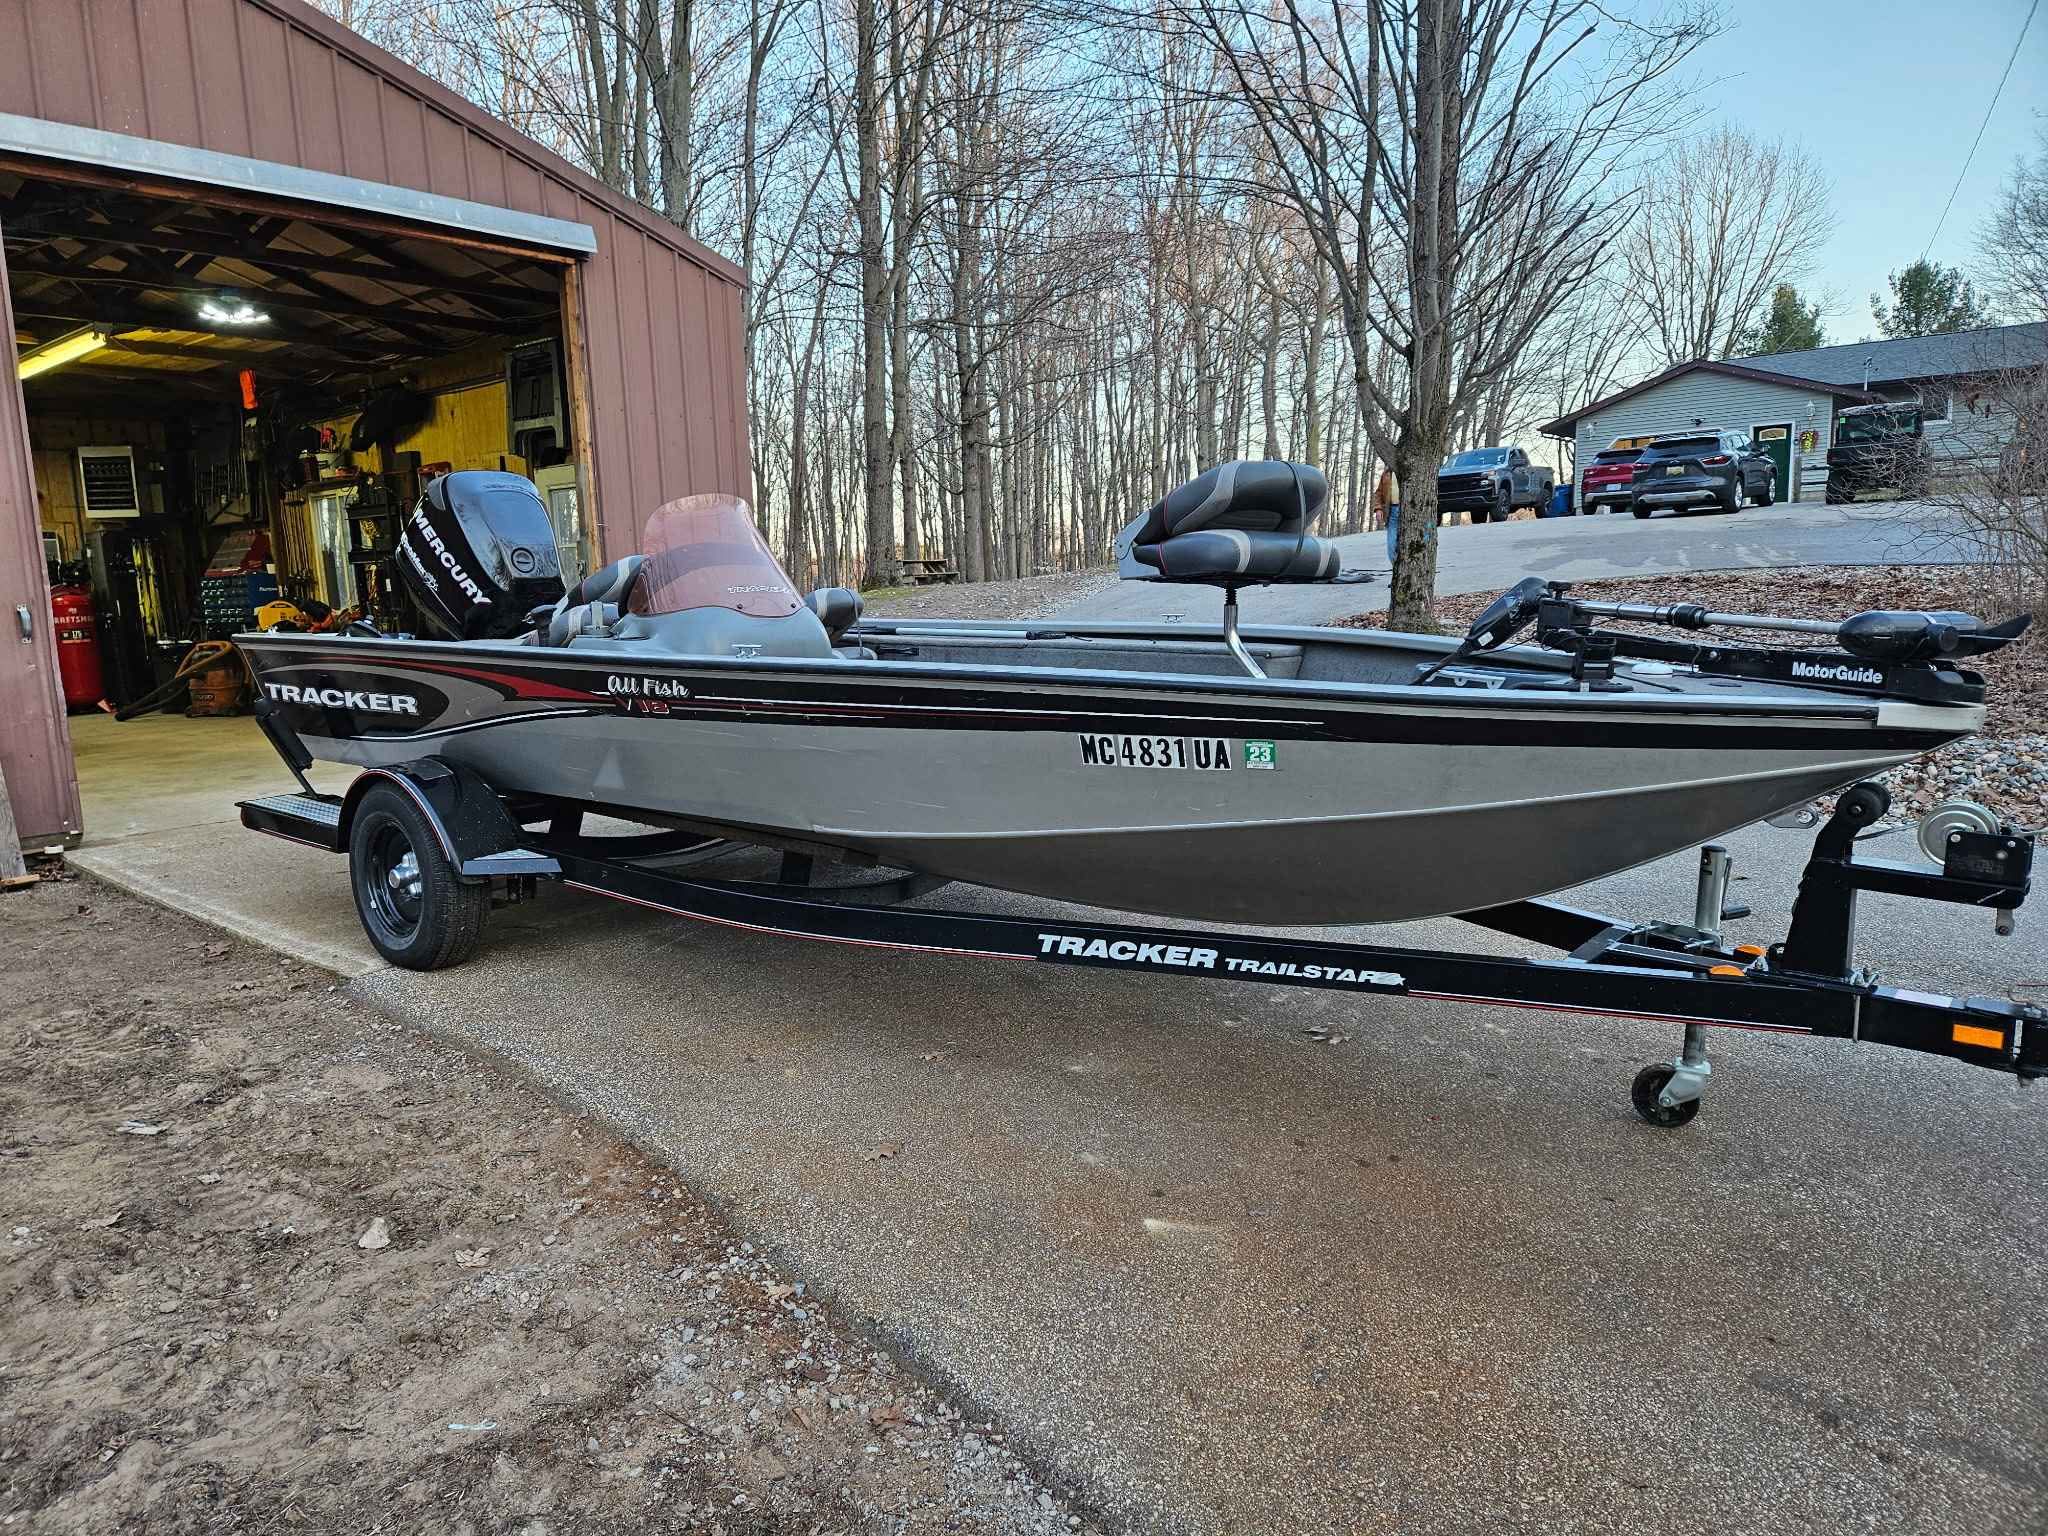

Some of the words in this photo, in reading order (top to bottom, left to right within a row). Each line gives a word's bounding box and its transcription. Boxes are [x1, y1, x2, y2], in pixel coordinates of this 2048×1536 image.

[413, 508, 492, 604] MERCURY
[643, 677, 689, 697] Fish
[1792, 661, 1883, 684] MotorGuide
[265, 683, 418, 714] TRACKER
[1080, 735, 1115, 765] MC
[1121, 737, 1186, 768] 4831
[1194, 739, 1231, 769] UA
[1249, 747, 1271, 762] 23
[1038, 933, 1220, 969] TRACKER
[1225, 957, 1379, 985] TRAILSTAR
